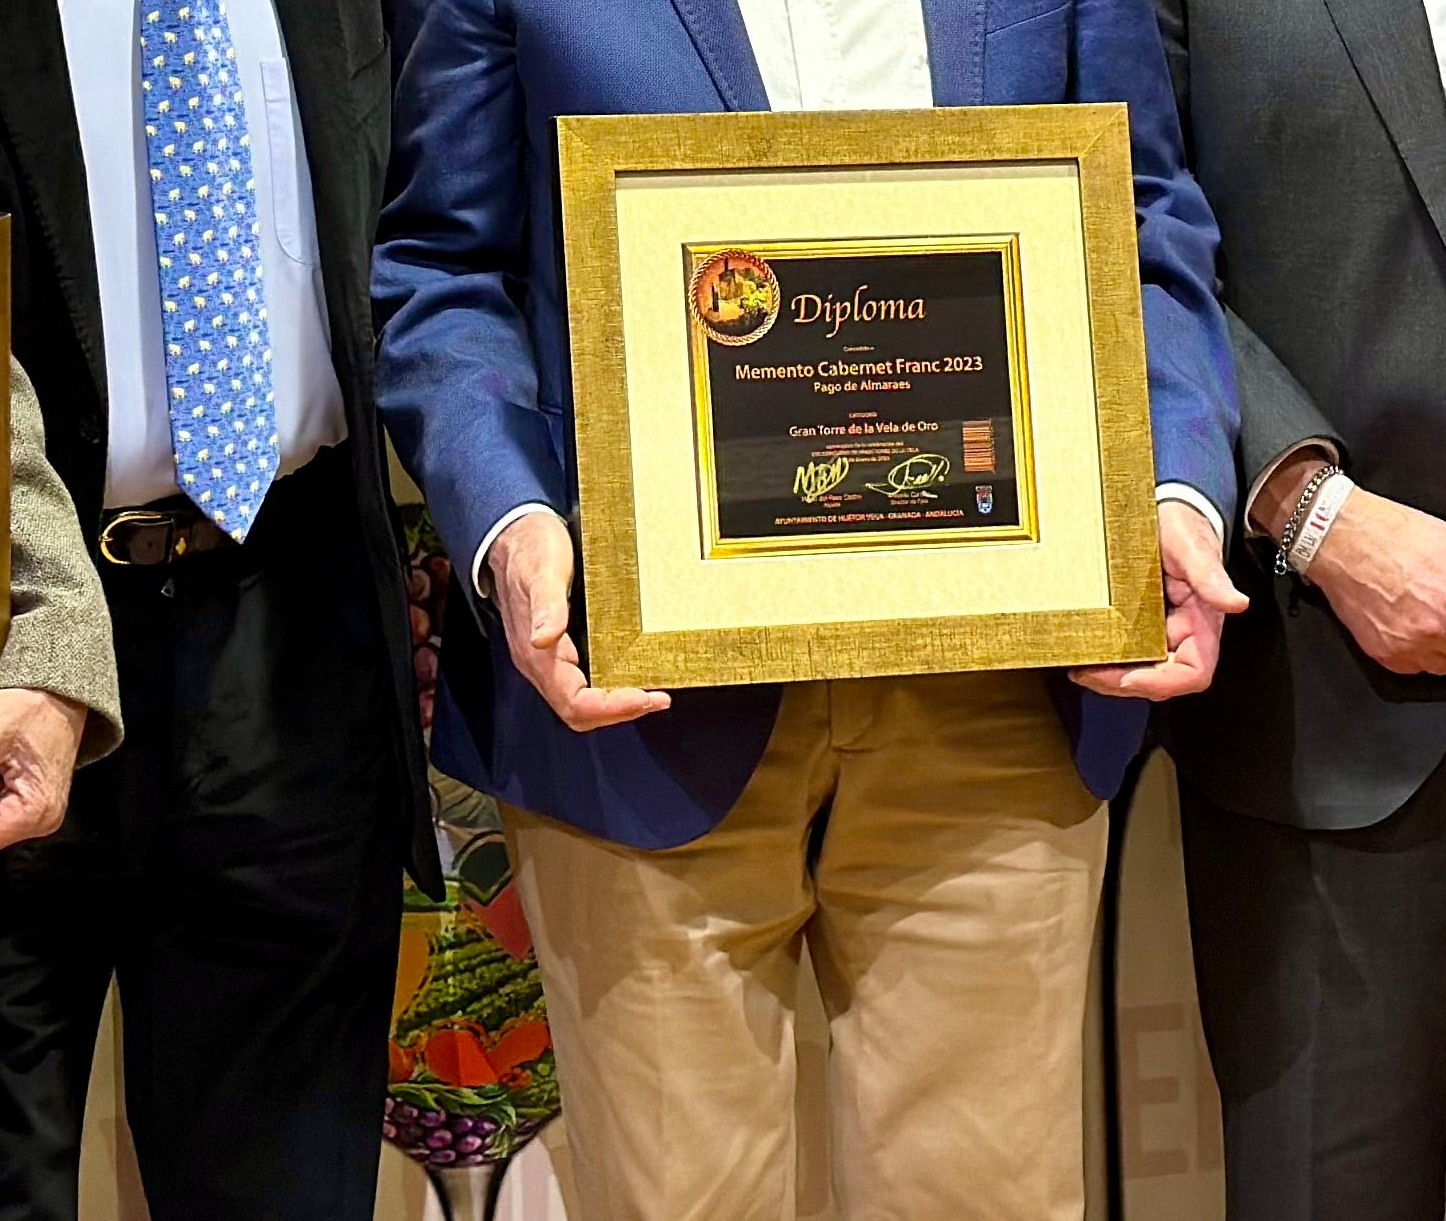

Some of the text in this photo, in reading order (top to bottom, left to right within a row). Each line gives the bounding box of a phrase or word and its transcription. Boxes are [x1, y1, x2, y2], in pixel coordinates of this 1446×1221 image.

[790, 284, 927, 339] Diploma
[735, 356, 984, 380] Memento Cabernet Franc 2023
[814, 382, 842, 395] Pago
[843, 380, 858, 392] de
[789, 420, 939, 438] Gran Torre de la Vela de Oro
